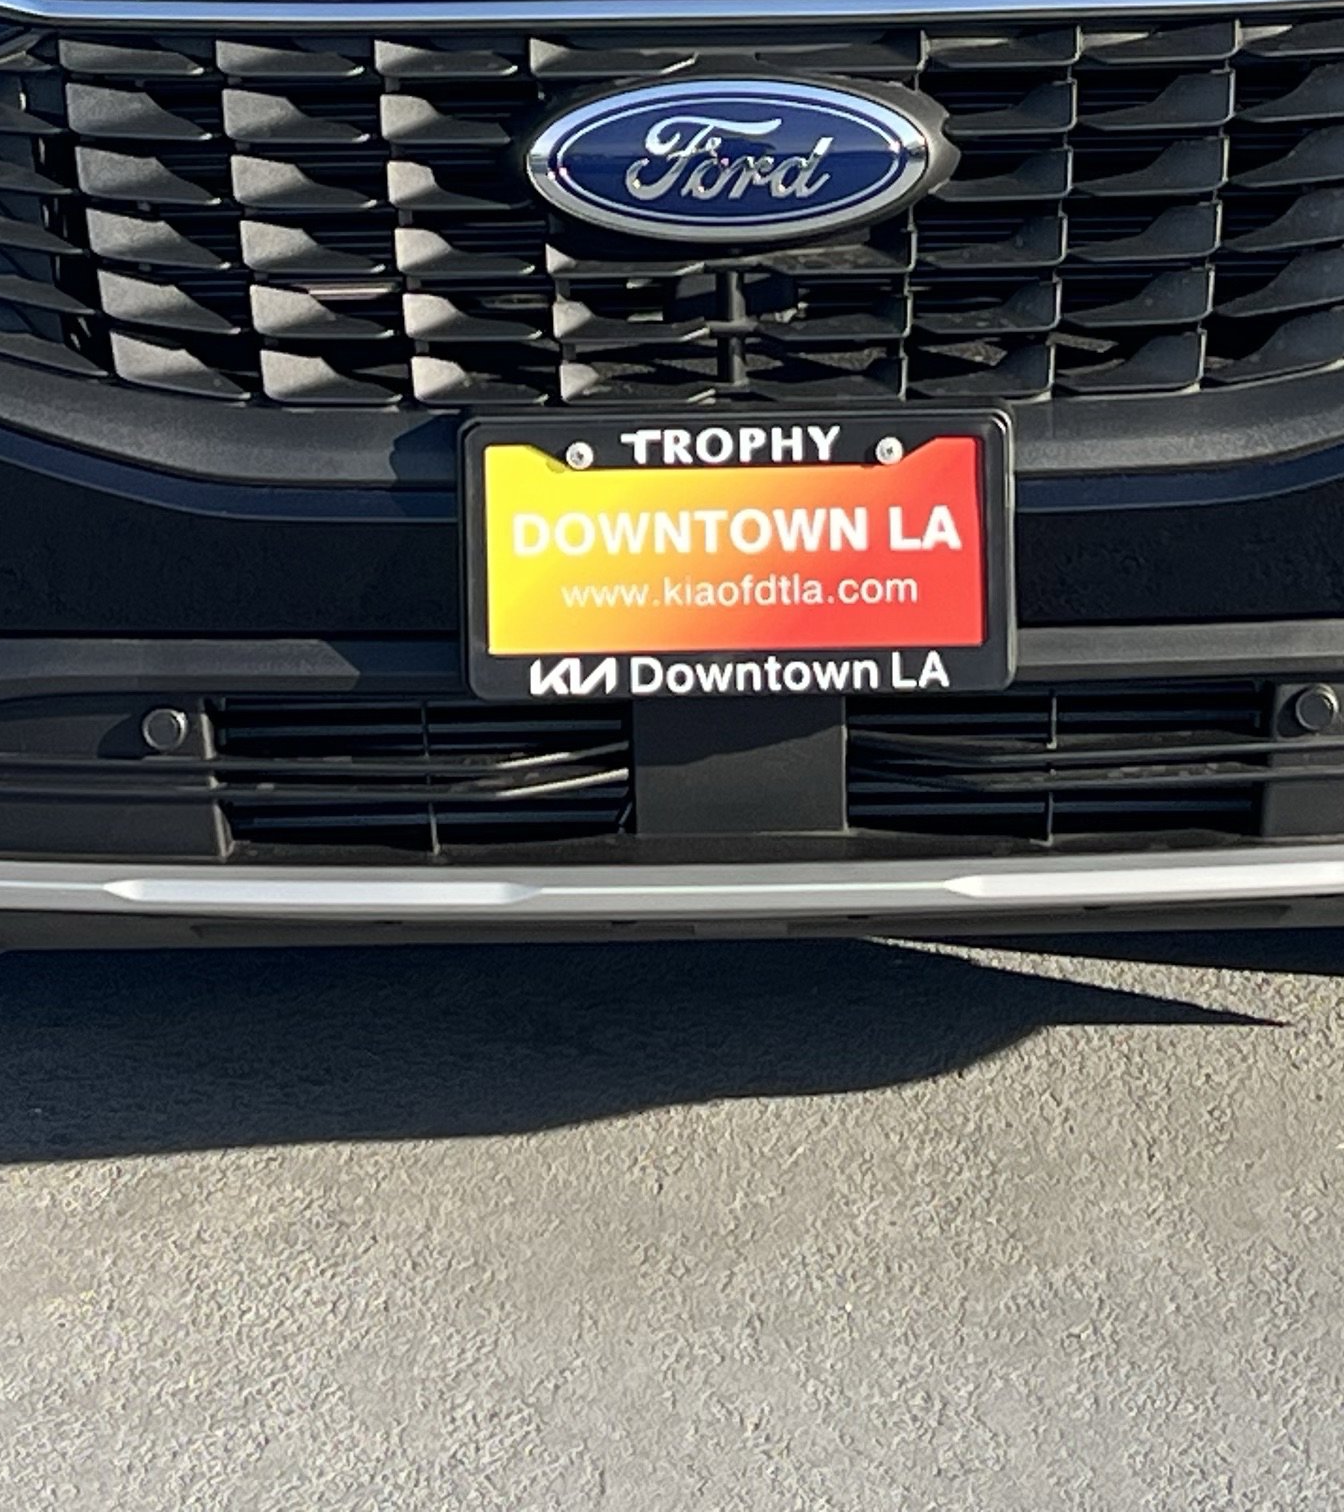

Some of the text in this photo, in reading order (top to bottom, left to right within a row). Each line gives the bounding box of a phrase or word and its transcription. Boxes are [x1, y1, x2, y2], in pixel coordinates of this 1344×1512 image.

[626, 115, 832, 201] Ford
[621, 425, 841, 465] TROPHY
[511, 505, 962, 556] DOWNTOWN LA
[561, 574, 918, 609] www.kiaofdtla.com
[629, 655, 879, 694] Downtown
[891, 651, 950, 689] LA
